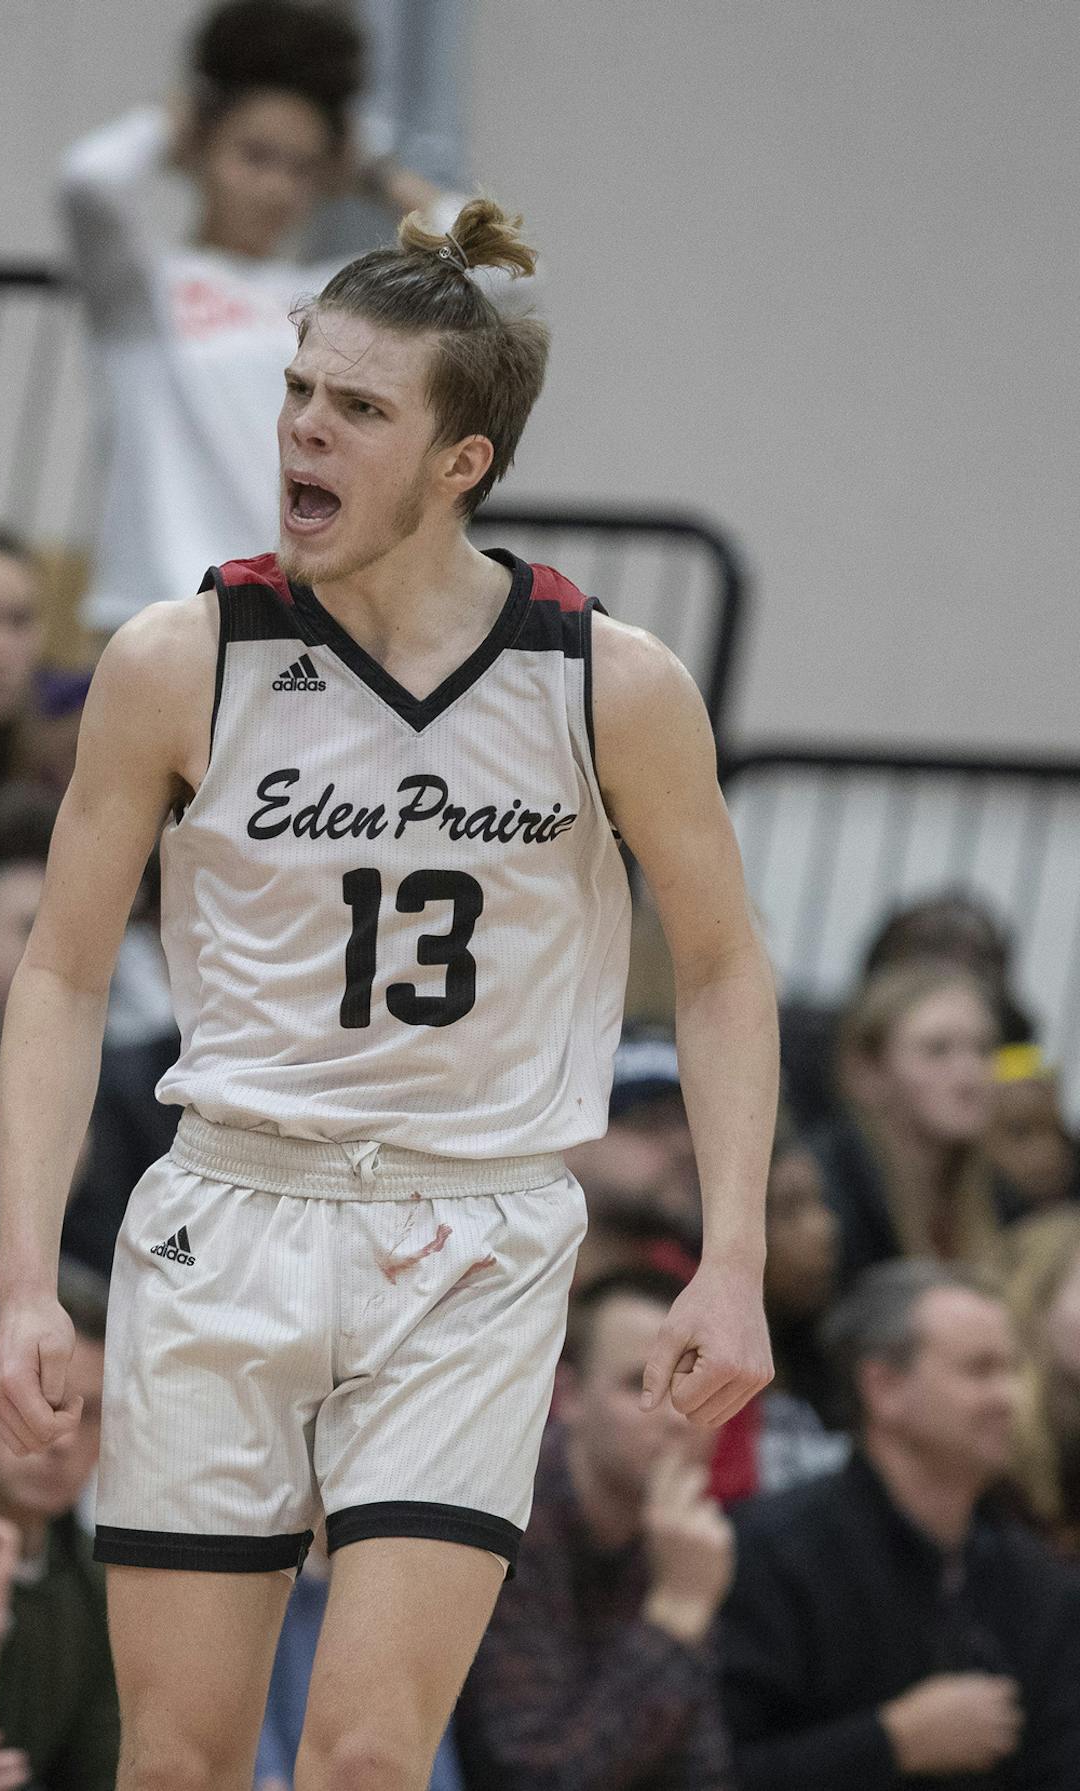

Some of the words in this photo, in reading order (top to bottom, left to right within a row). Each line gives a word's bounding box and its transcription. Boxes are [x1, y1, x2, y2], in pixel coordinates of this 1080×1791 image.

[272, 677, 327, 692] adidas
[247, 768, 389, 840] Eden
[394, 774, 577, 843] Prairie
[340, 868, 484, 1029] 13
[150, 1241, 196, 1267] adidas
